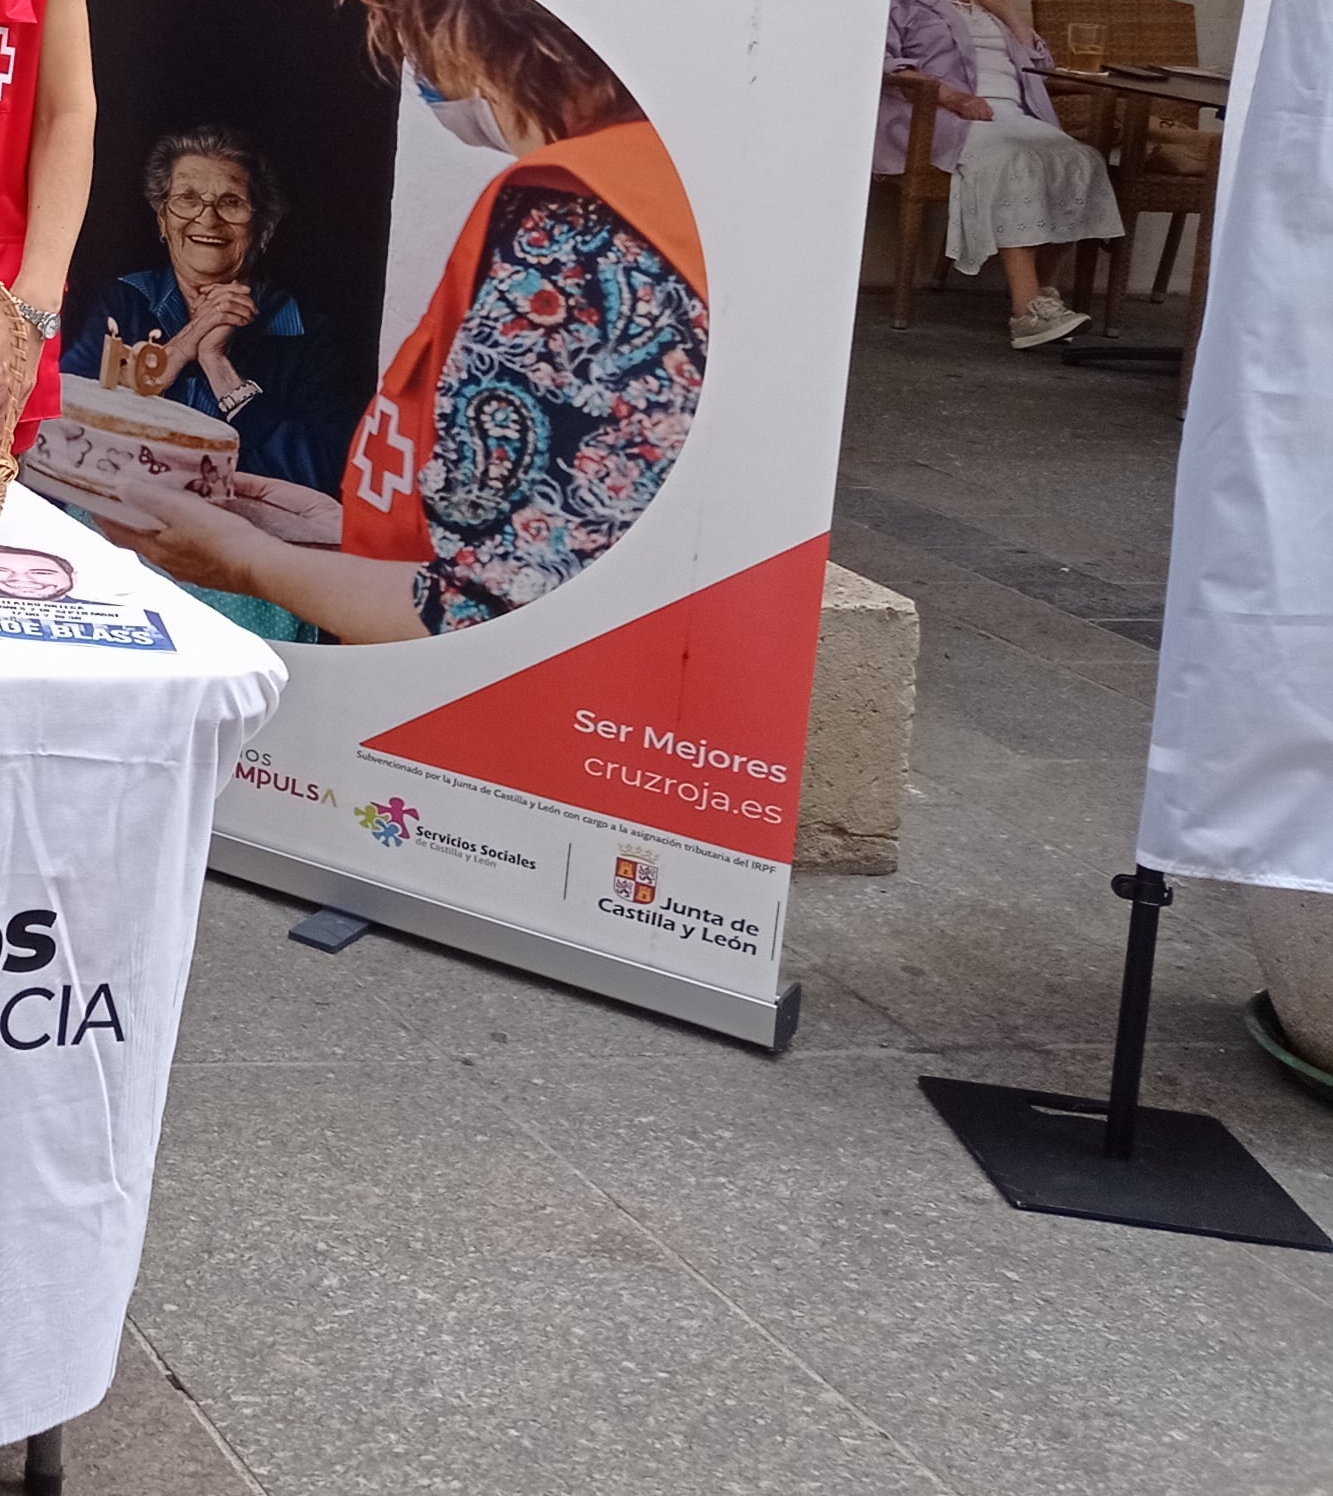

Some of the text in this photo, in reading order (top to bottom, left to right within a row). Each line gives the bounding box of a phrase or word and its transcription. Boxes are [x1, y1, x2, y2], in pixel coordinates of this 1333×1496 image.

[50, 620, 155, 646] BLASS
[240, 749, 272, 767] OS
[573, 709, 787, 784] Ser Mejores
[235, 761, 337, 808] MPULSA
[584, 757, 783, 825] cruzroja.es
[356, 750, 423, 777] Subvencionado
[425, 771, 440, 783] por
[443, 775, 451, 785] la
[452, 777, 478, 792] Junta
[479, 785, 492, 796] de
[493, 790, 527, 806] Castilla
[529, 800, 536, 810] y
[538, 802, 561, 816] León
[563, 810, 581, 821] con
[582, 816, 608, 830] cargo
[619, 823, 628, 835] la
[630, 828, 682, 849] asignación
[684, 842, 731, 864] tributaria
[733, 855, 749, 868] del
[751, 860, 777, 875] IRPF
[415, 838, 497, 868] de Castilla y León
[416, 825, 536, 870] Servicios Sociales
[598, 897, 757, 956] Castilla y León
[660, 897, 760, 937] Junta de
